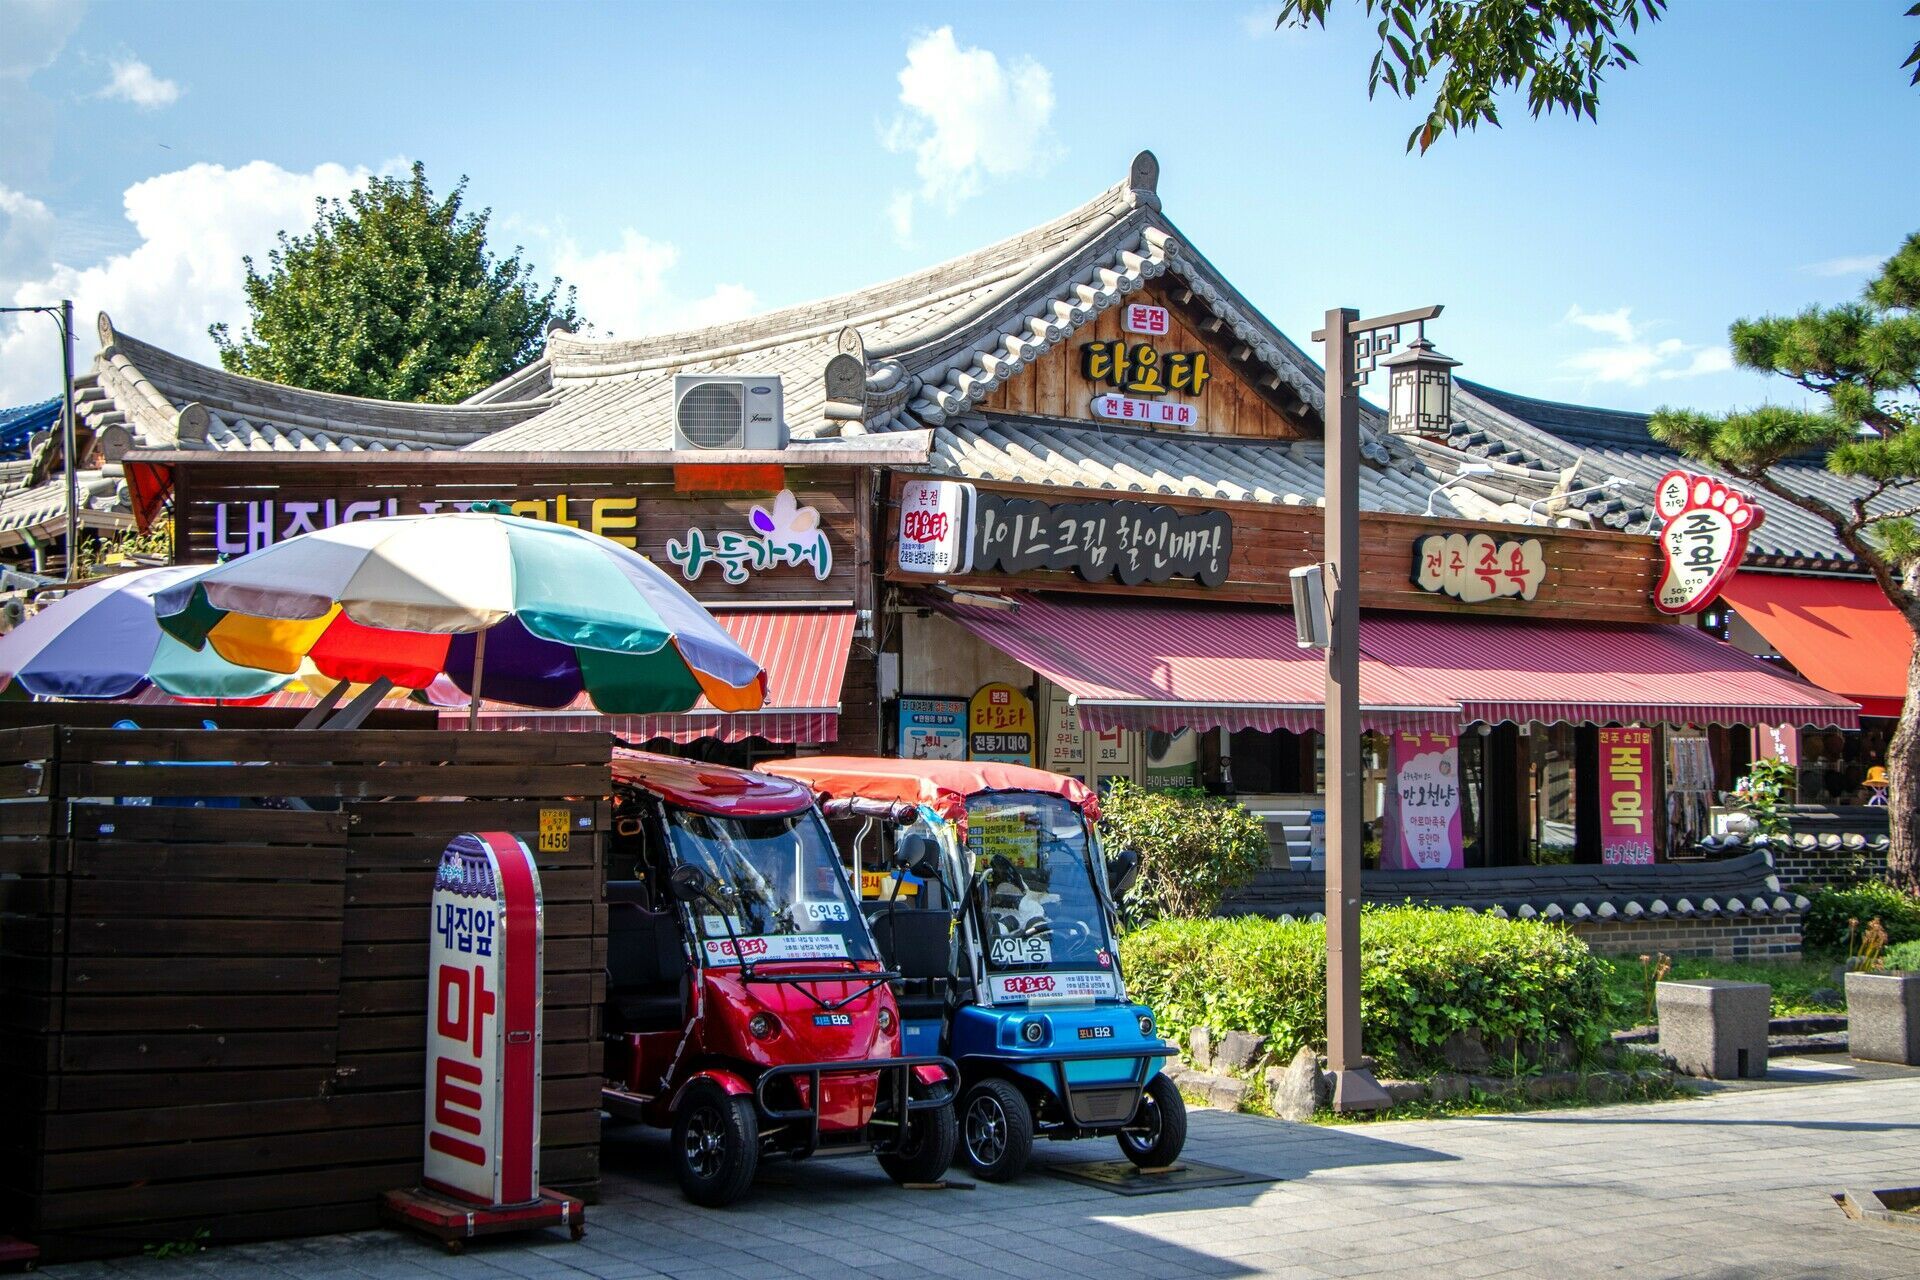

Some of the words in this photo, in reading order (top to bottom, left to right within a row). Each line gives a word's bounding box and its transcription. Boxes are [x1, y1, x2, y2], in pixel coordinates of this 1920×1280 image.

[1132, 307, 1164, 332] 본점
[1089, 341, 1211, 396] 타요타
[1106, 399, 1150, 419] 전동기
[1162, 405, 1190, 423] 대여
[919, 489, 938, 506] 본점
[1666, 483, 1680, 499] 손
[1665, 499, 1685, 508] 지압
[905, 511, 948, 543] 타요타
[1671, 533, 1683, 557] 전주
[1683, 514, 1722, 577] 족욕
[671, 531, 828, 581] 나들가게
[1427, 550, 1465, 577] 전주
[1475, 543, 1530, 594] 족욕
[1685, 578, 1703, 586] 010
[1671, 586, 1694, 595] 5092
[1663, 596, 1686, 605] 2388
[992, 692, 1008, 703] 본점
[976, 707, 1026, 729] 타요타
[1060, 705, 1075, 717] 나도
[1060, 720, 1075, 730] 너도
[975, 735, 1005, 751] 전동기
[1008, 736, 1028, 751] 대여
[1057, 733, 1079, 745] 우리도
[1600, 732, 1619, 743] 전주
[1624, 732, 1650, 744] 손지압
[1101, 749, 1117, 759] 요타
[1147, 775, 1194, 787] 라이노바이크
[1610, 747, 1643, 834] 족욕
[1410, 816, 1446, 828] 아로마족욕
[541, 833, 568, 848] 1458
[1419, 850, 1440, 863] 발지압
[809, 903, 845, 921] 6인용
[435, 903, 495, 957] 내집앞
[707, 943, 718, 951] 43
[720, 938, 768, 957] 타요타
[991, 937, 1047, 964] 4인용
[1099, 953, 1111, 964] 30
[1004, 976, 1056, 994] 타요타
[831, 1014, 849, 1025] 타요
[1080, 1029, 1093, 1038] 포니
[1094, 1027, 1112, 1037] 타요
[429, 963, 496, 1167] 마트
